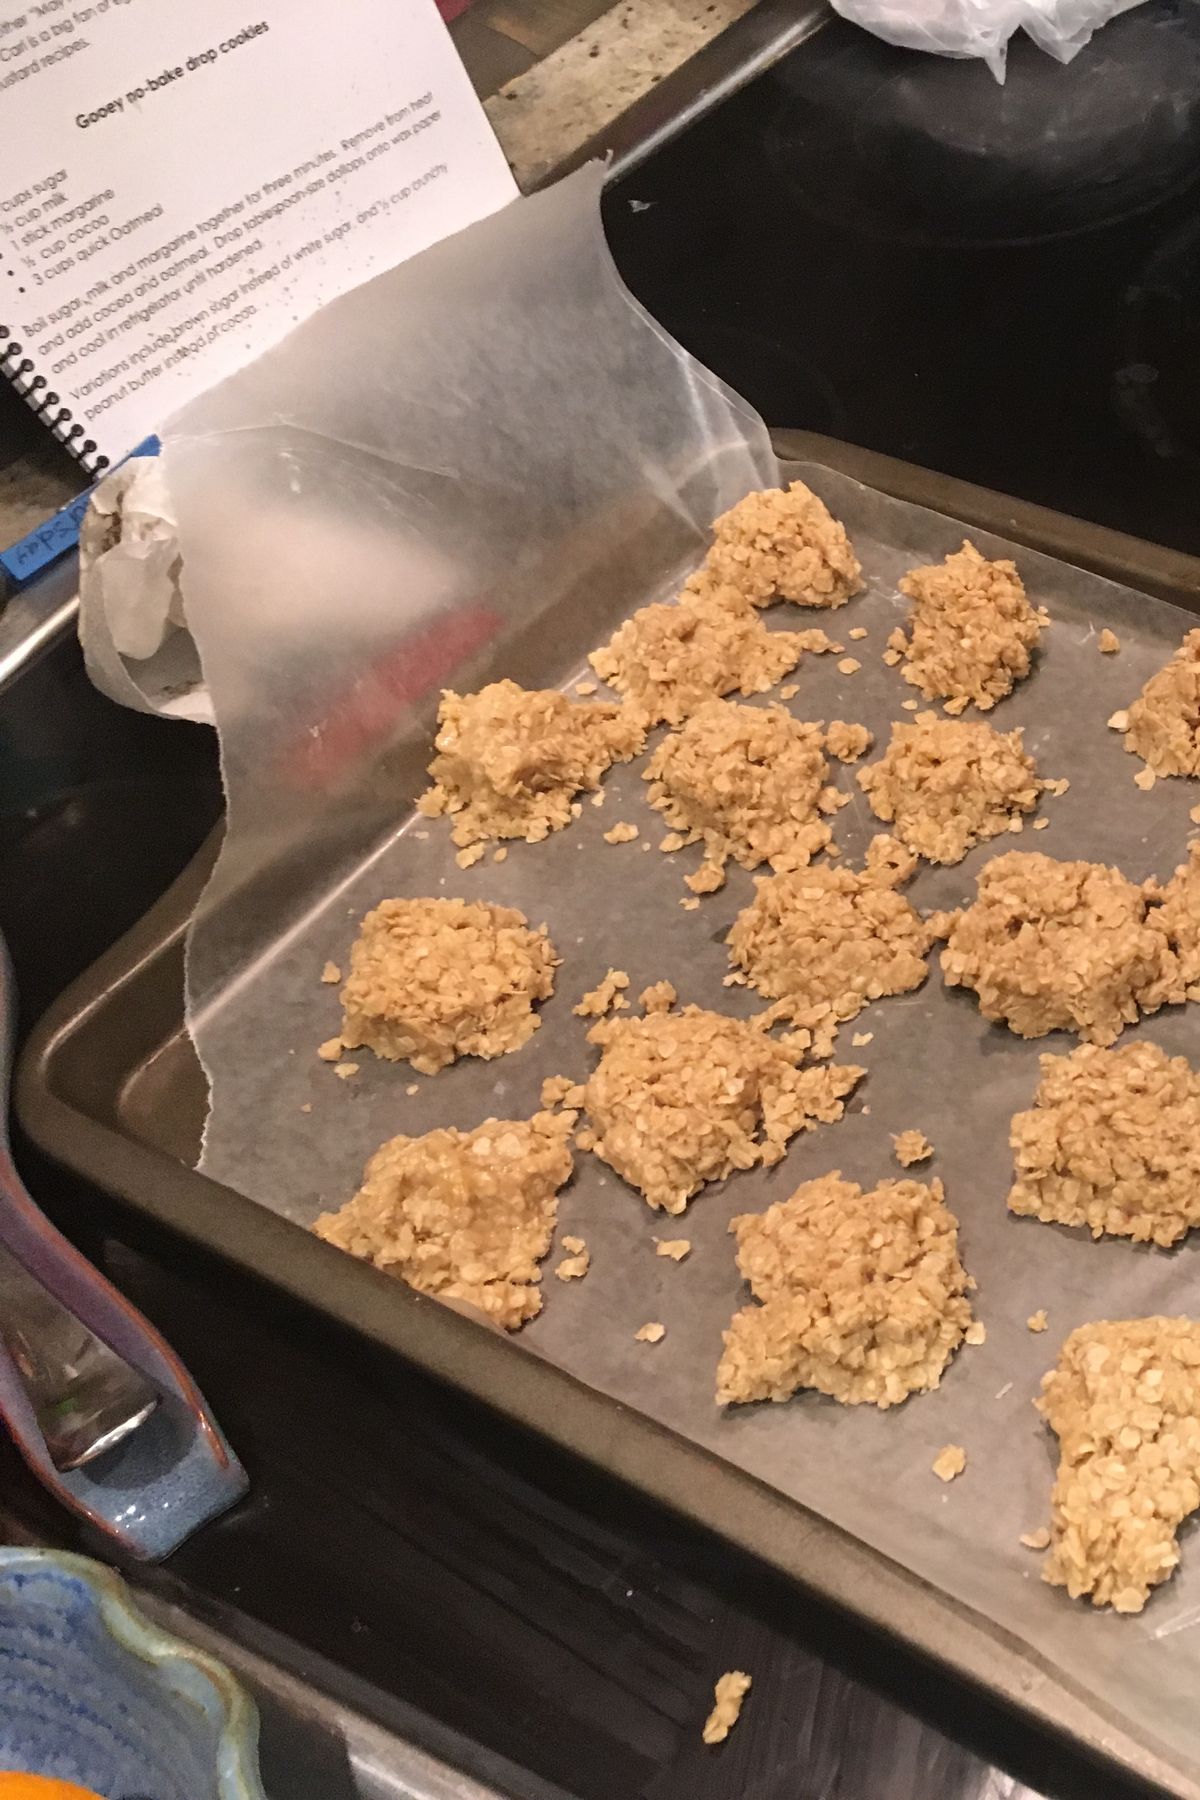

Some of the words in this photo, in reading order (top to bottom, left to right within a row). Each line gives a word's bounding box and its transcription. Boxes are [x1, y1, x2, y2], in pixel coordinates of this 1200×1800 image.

[39, 30, 51, 42] a
[50, 19, 75, 36] big
[72, 8, 97, 23] fan
[75, 98, 125, 129] Gooey
[125, 66, 185, 103] no-bake
[185, 48, 218, 71] drop
[219, 21, 270, 54] cookies
[0, 190, 33, 212] cups
[32, 169, 68, 195] sugar
[14, 208, 42, 227] cup
[41, 192, 69, 212] milk
[21, 225, 52, 247] stick
[50, 189, 115, 229] margarine
[22, 317, 47, 337] Boil
[86, 281, 111, 300] milk
[111, 263, 137, 285] and
[137, 230, 197, 269] margarine
[196, 201, 245, 233] together
[245, 191, 262, 204] for
[262, 174, 293, 195] three
[340, 121, 386, 151] Remove
[385, 107, 411, 126] from
[409, 91, 433, 111] heat
[38, 333, 64, 355] and
[66, 316, 93, 339] add
[93, 293, 134, 322] cocoa
[134, 276, 159, 297] and
[213, 227, 243, 249] Drop
[243, 178, 325, 231] tablespoon-size
[326, 156, 366, 183] dollops
[366, 141, 391, 161] onto
[391, 129, 413, 144] wax
[412, 110, 442, 135] paper
[32, 273, 44, 286] 3
[44, 257, 76, 279] cups
[76, 236, 112, 261] quick
[109, 202, 164, 240] Oatmeal
[40, 240, 66, 259] cup
[67, 214, 110, 244] cocoa
[69, 359, 130, 400] Variations
[171, 310, 210, 339] brown
[209, 289, 240, 314] sugar
[239, 264, 281, 295] instead
[281, 254, 293, 270] of
[293, 239, 323, 261] white
[357, 205, 379, 224] and
[390, 187, 412, 204] cup
[412, 163, 447, 190] crunchy
[52, 351, 78, 374] and
[79, 333, 106, 357] cool
[106, 327, 120, 340] in
[119, 289, 181, 333] refrigerator
[183, 272, 207, 294] until
[84, 385, 129, 421] peanut
[127, 364, 163, 391] butter
[163, 335, 207, 369] instead
[206, 325, 220, 344] of
